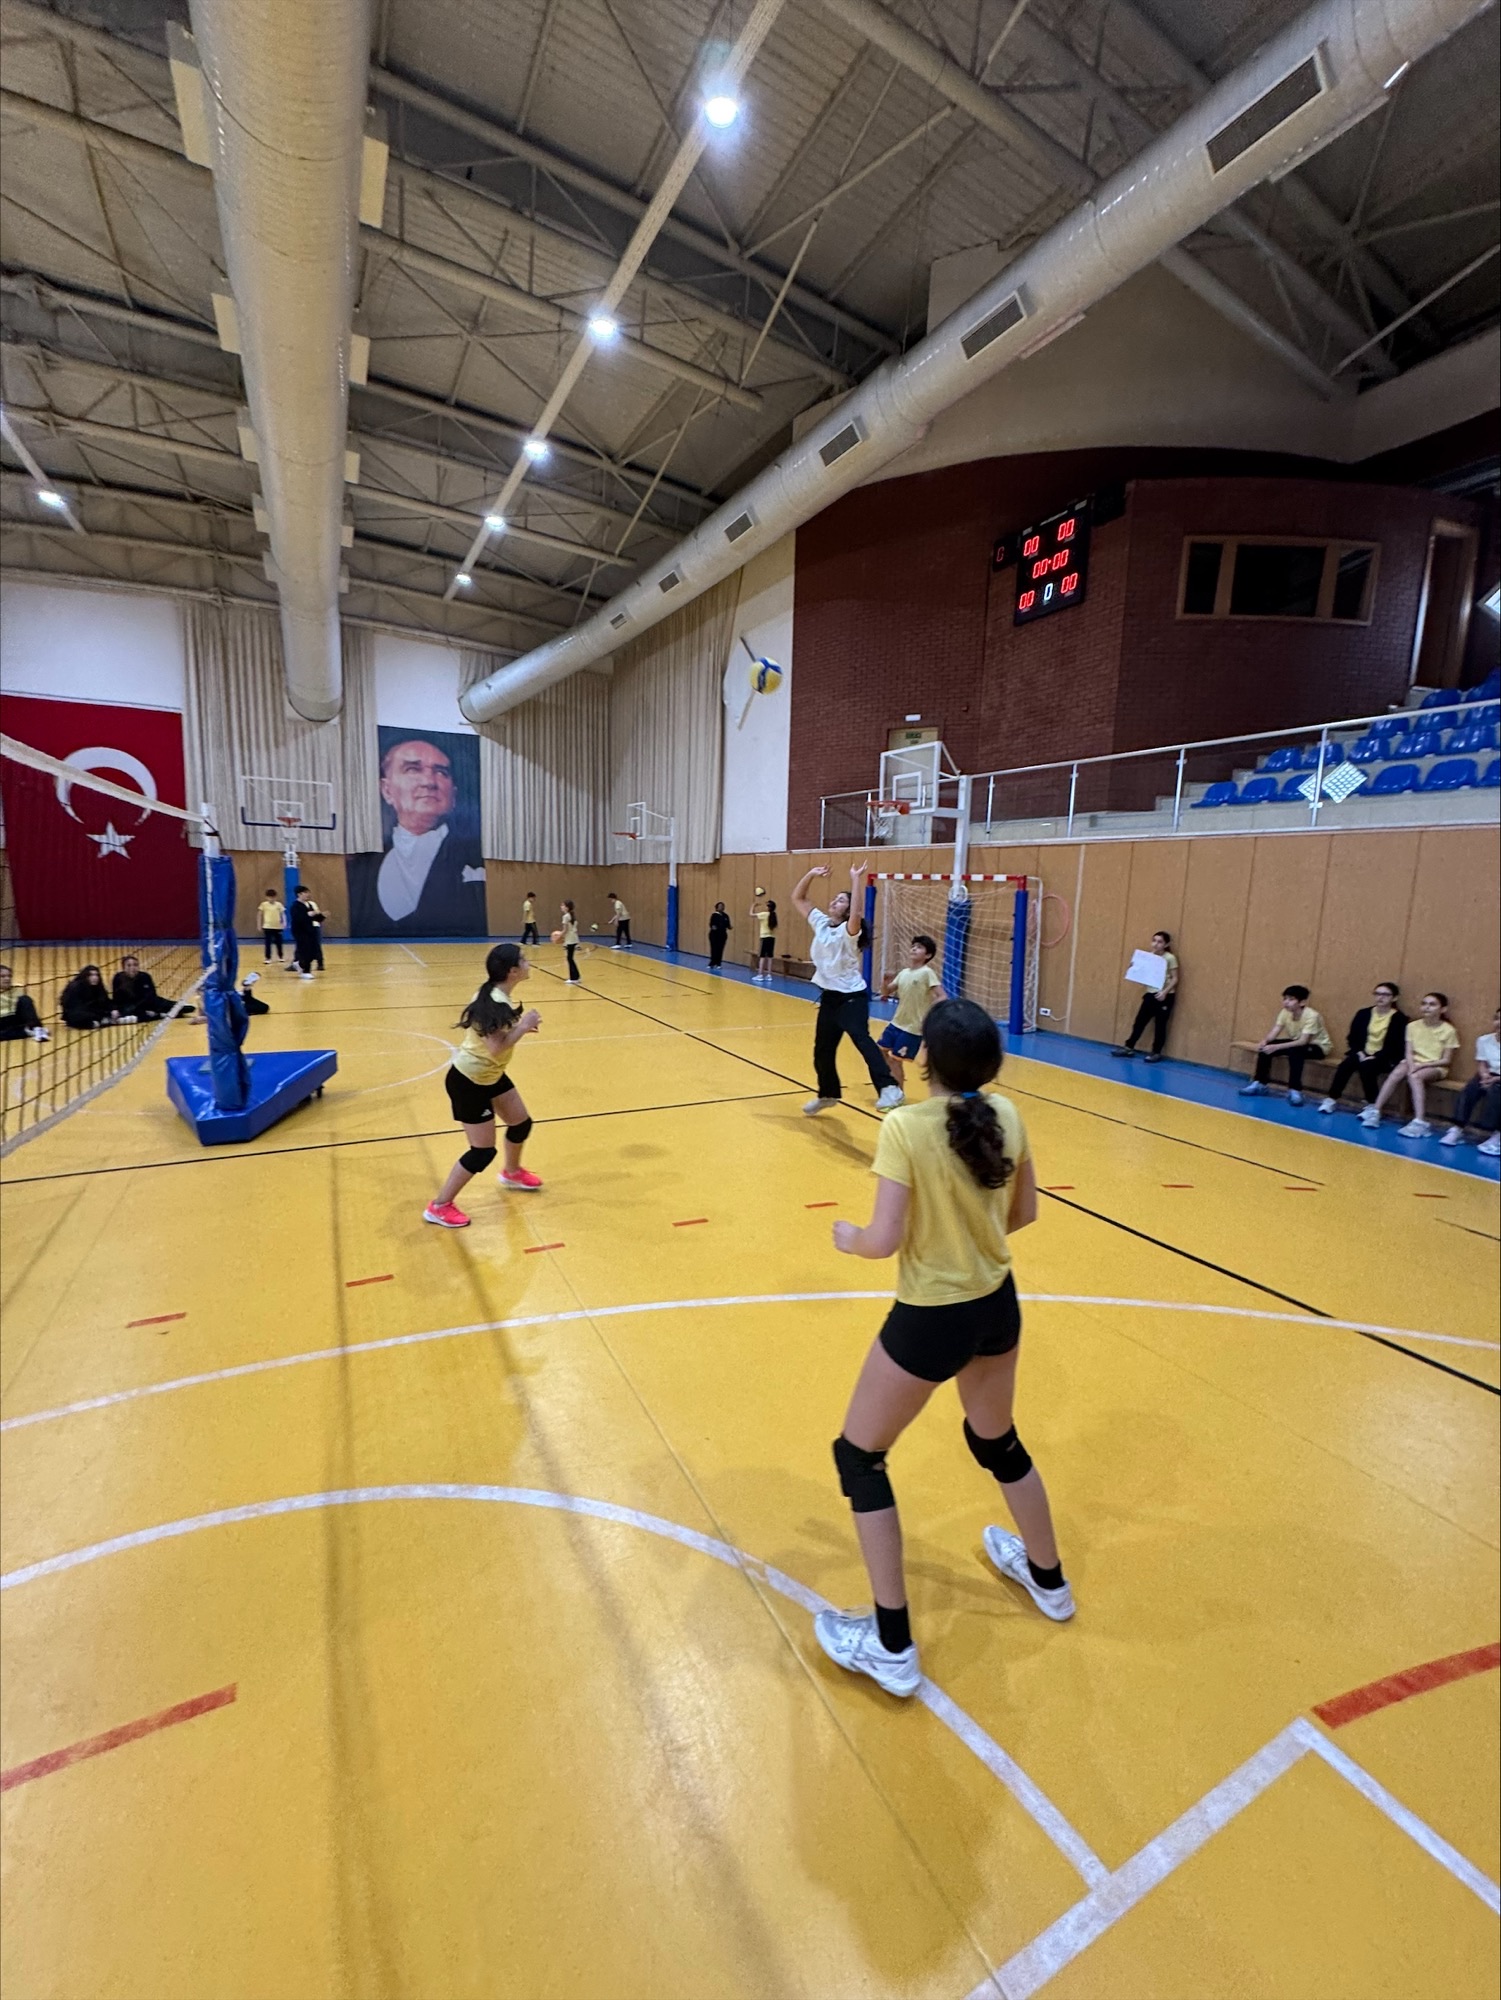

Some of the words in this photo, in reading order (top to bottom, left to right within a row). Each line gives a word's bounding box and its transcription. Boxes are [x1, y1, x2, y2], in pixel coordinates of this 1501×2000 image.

[1023, 535, 1040, 556] 00
[1057, 518, 1075, 541] 00
[1018, 590, 1035, 610] 00
[1043, 583, 1053, 601] 0
[1060, 572, 1078, 594] 00
